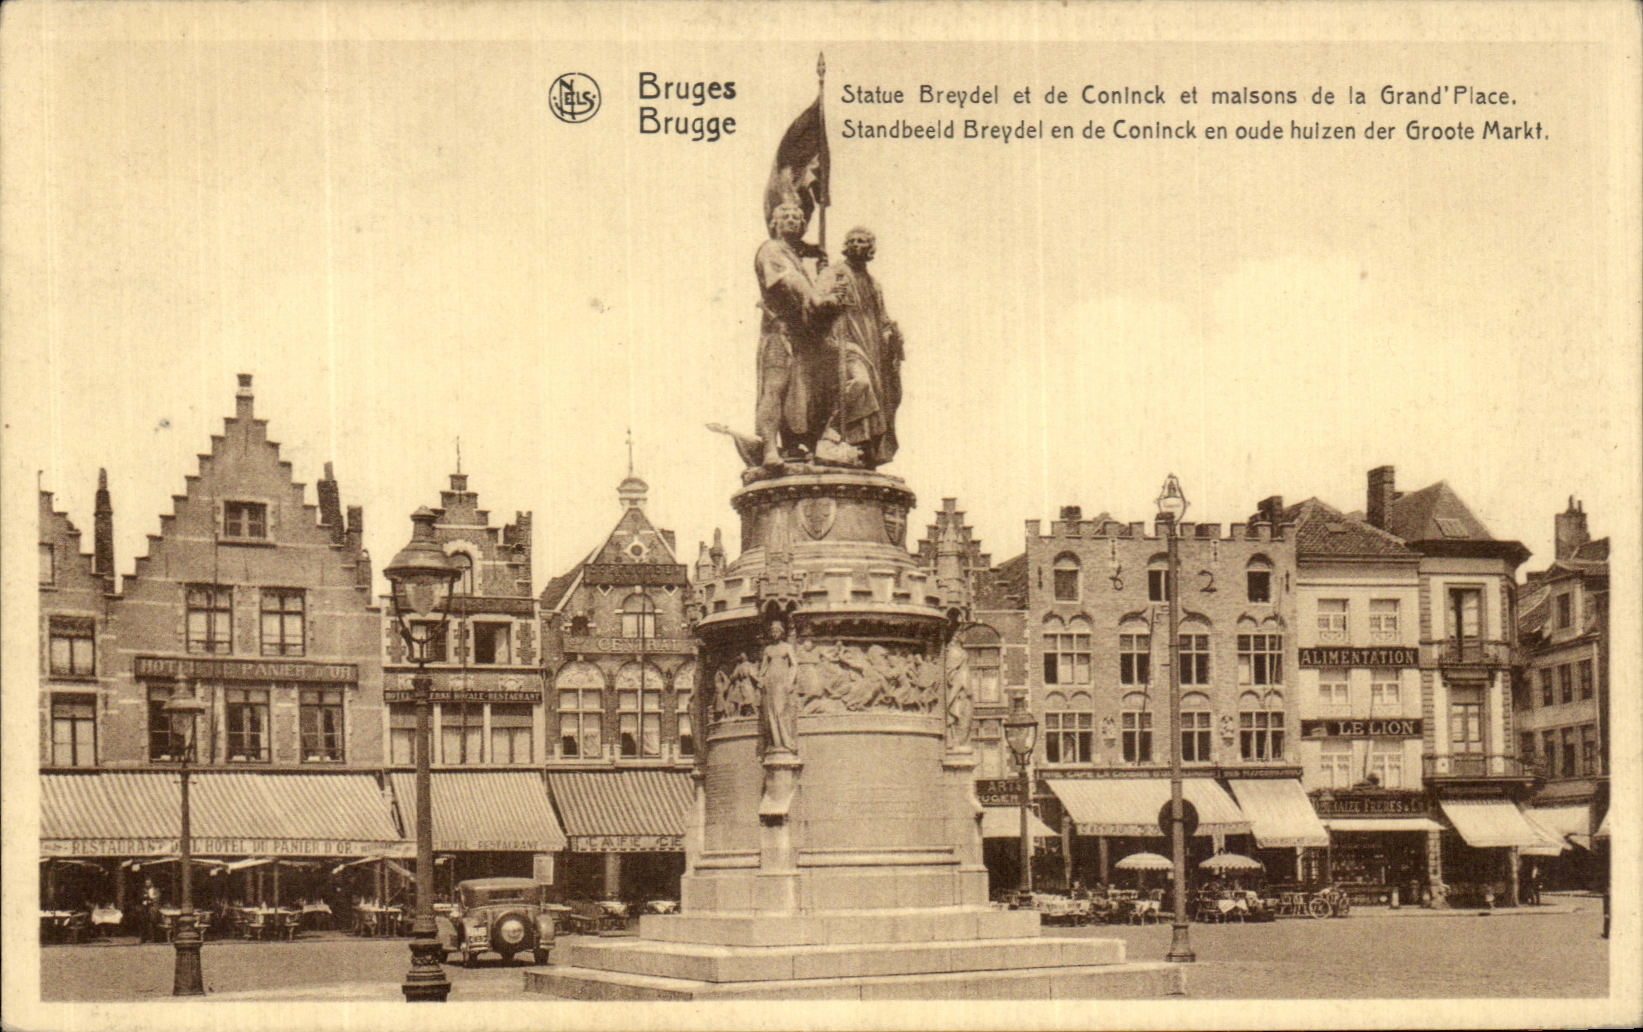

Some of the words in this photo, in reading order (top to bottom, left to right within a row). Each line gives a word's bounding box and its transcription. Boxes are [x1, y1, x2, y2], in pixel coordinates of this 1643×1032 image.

[1300, 650, 1414, 665] ALIMENTATION
[1339, 721, 1365, 735] LE
[1368, 721, 1414, 735] LION
